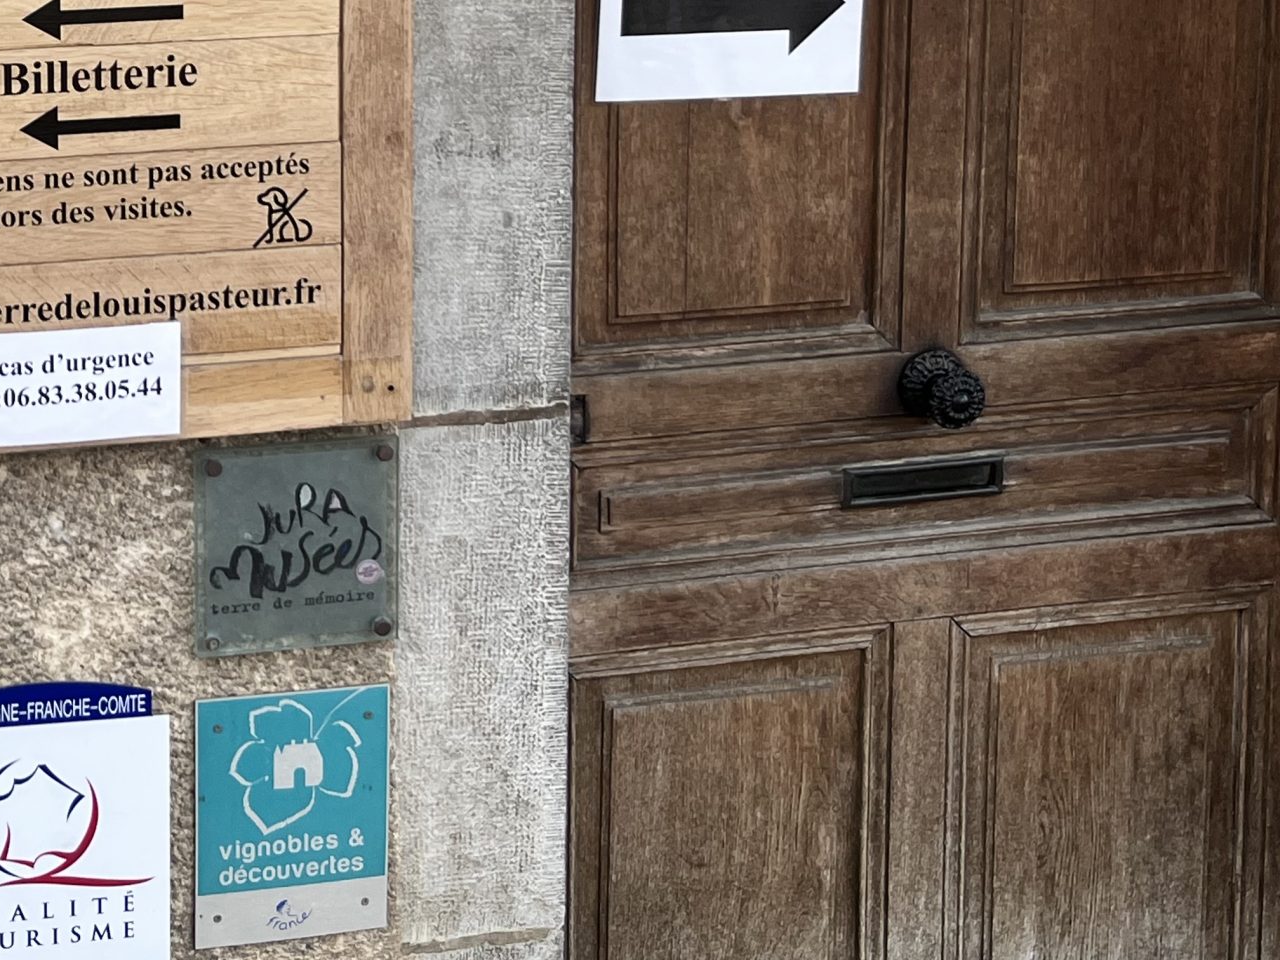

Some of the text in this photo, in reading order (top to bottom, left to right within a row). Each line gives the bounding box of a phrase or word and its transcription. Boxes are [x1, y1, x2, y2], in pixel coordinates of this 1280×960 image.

[0, 54, 198, 97] Billetterie
[44, 169, 76, 191] ne
[83, 162, 139, 188] sont
[147, 161, 192, 194] pas
[200, 152, 310, 183] acceptés
[52, 197, 95, 225] des
[103, 194, 193, 222] visites.
[211, 590, 375, 615] terre de mémoire
[219, 827, 365, 864] vignobles &
[219, 855, 364, 886] découvertes
